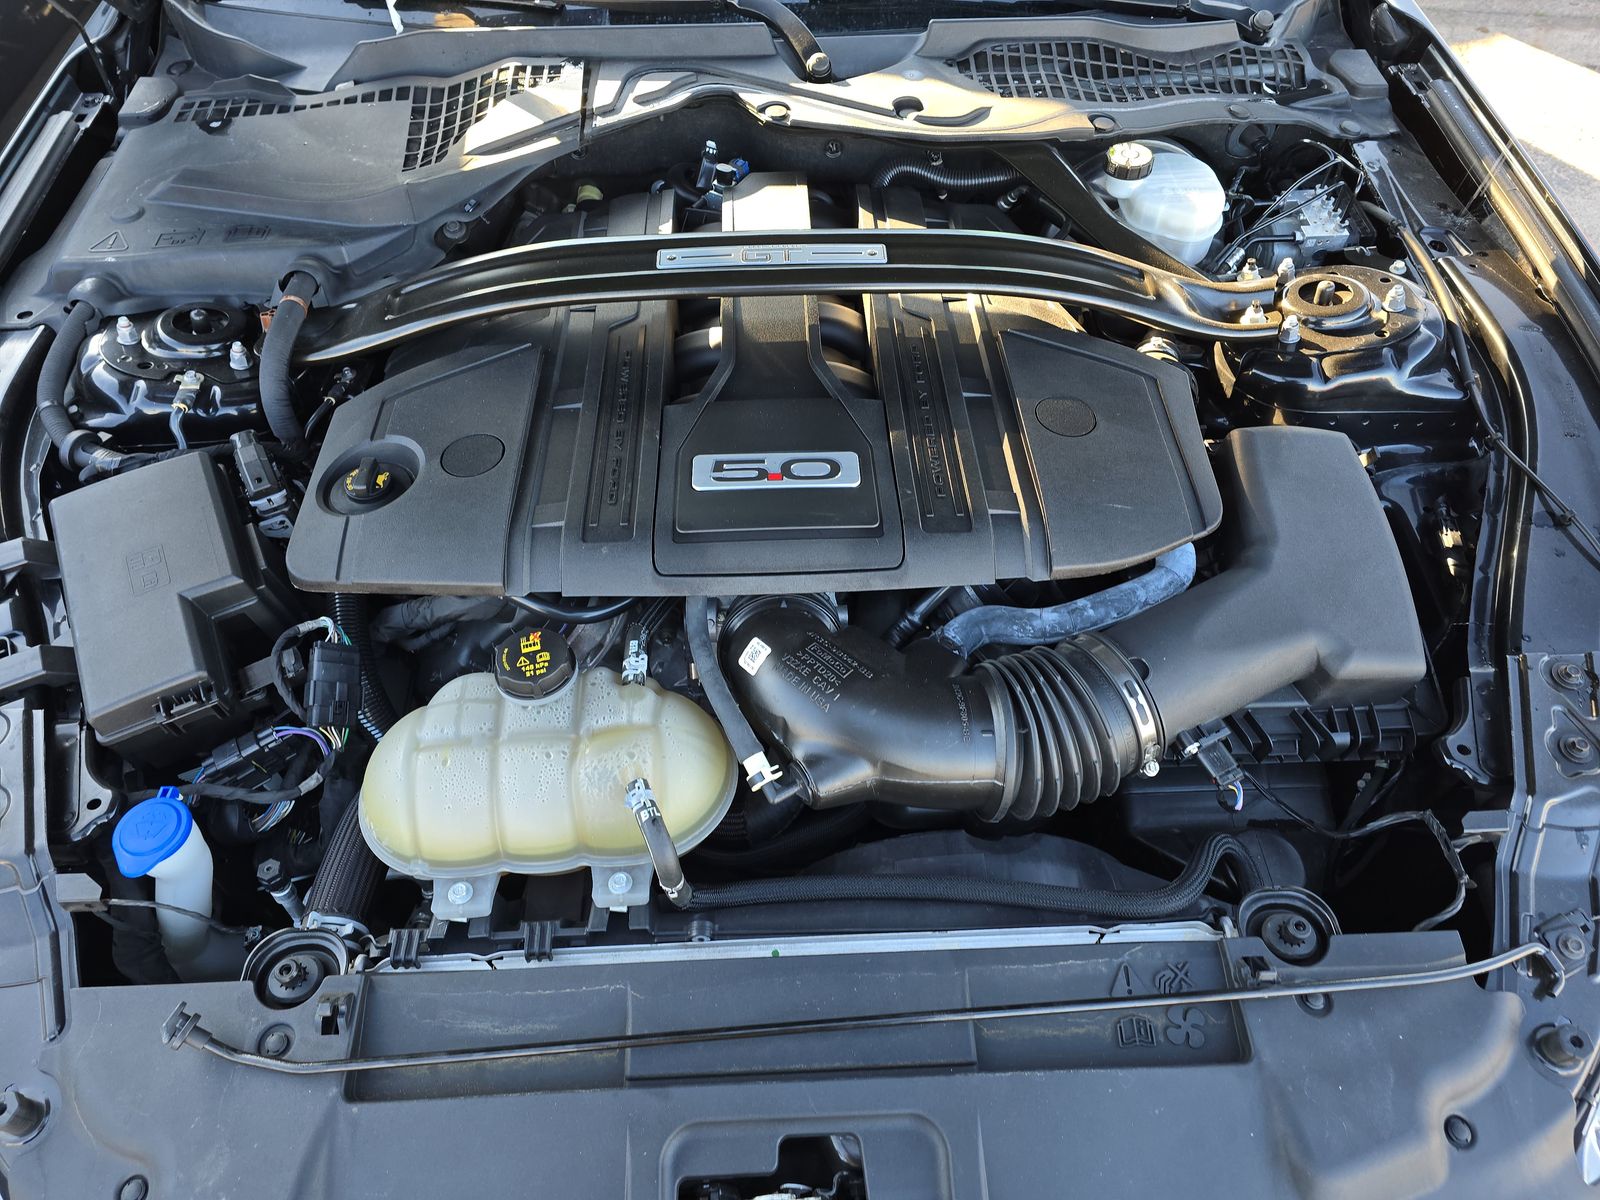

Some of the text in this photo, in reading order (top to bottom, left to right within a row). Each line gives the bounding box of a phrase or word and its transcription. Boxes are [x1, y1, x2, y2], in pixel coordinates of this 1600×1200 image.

[741, 248, 803, 263] GT
[924, 417, 947, 498] POWERED
[710, 457, 842, 482] 5.0
[809, 690, 831, 713] USA
[640, 806, 661, 823] BTL
